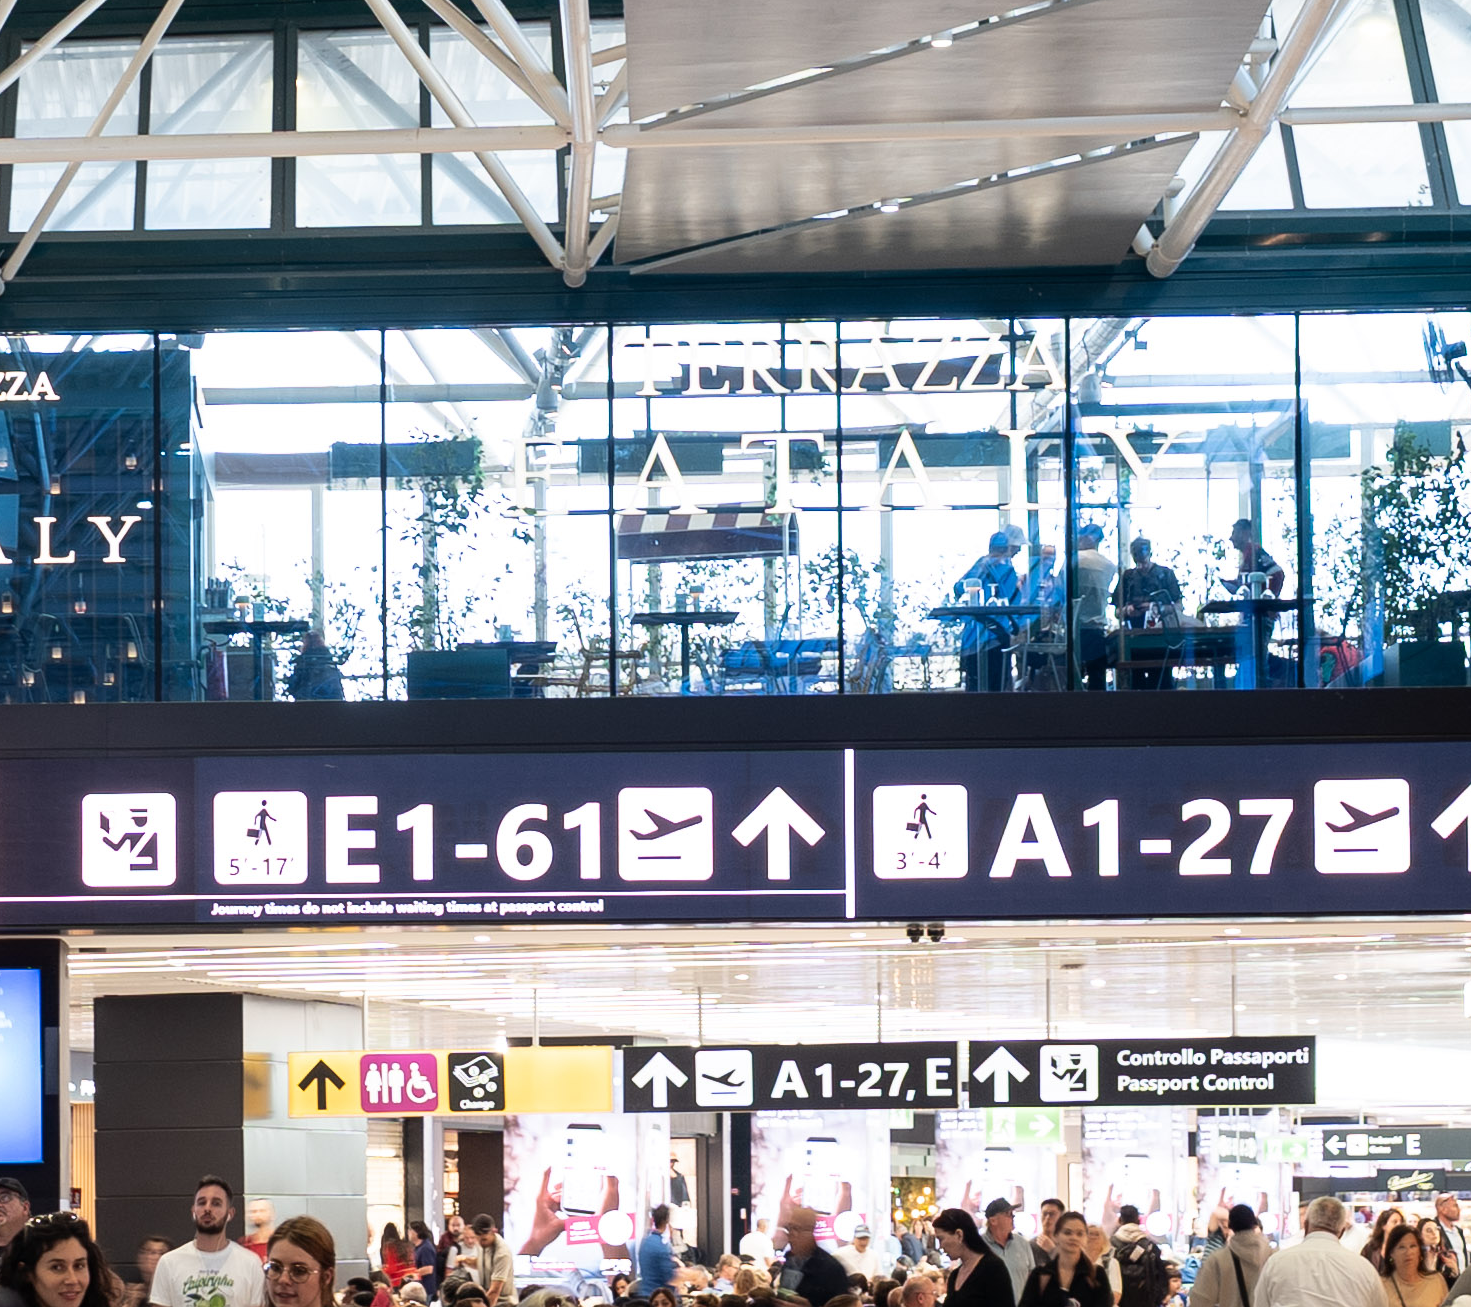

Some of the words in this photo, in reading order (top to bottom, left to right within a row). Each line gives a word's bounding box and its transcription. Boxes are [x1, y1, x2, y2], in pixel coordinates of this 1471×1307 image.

[636, 332, 1066, 396] TERRAZZA
[514, 429, 1201, 516] EATALY
[324, 794, 602, 885] E1-61
[988, 792, 1295, 879] A1-27
[211, 902, 263, 917] Journey
[264, 902, 300, 914] times
[302, 901, 319, 914] do
[321, 902, 345, 914] not
[347, 901, 394, 914] include
[396, 901, 443, 916] waiting
[445, 900, 482, 913] times
[484, 901, 497, 913] at
[499, 900, 555, 915] passport
[557, 899, 604, 912] control
[772, 1060, 917, 1103] A1-27,
[927, 1057, 952, 1098] E
[1116, 1047, 1205, 1069] Controllo
[1210, 1045, 1310, 1070] Passaporti
[460, 1097, 496, 1111] Change
[1117, 1073, 1200, 1097] Passport
[1204, 1072, 1275, 1093] Control
